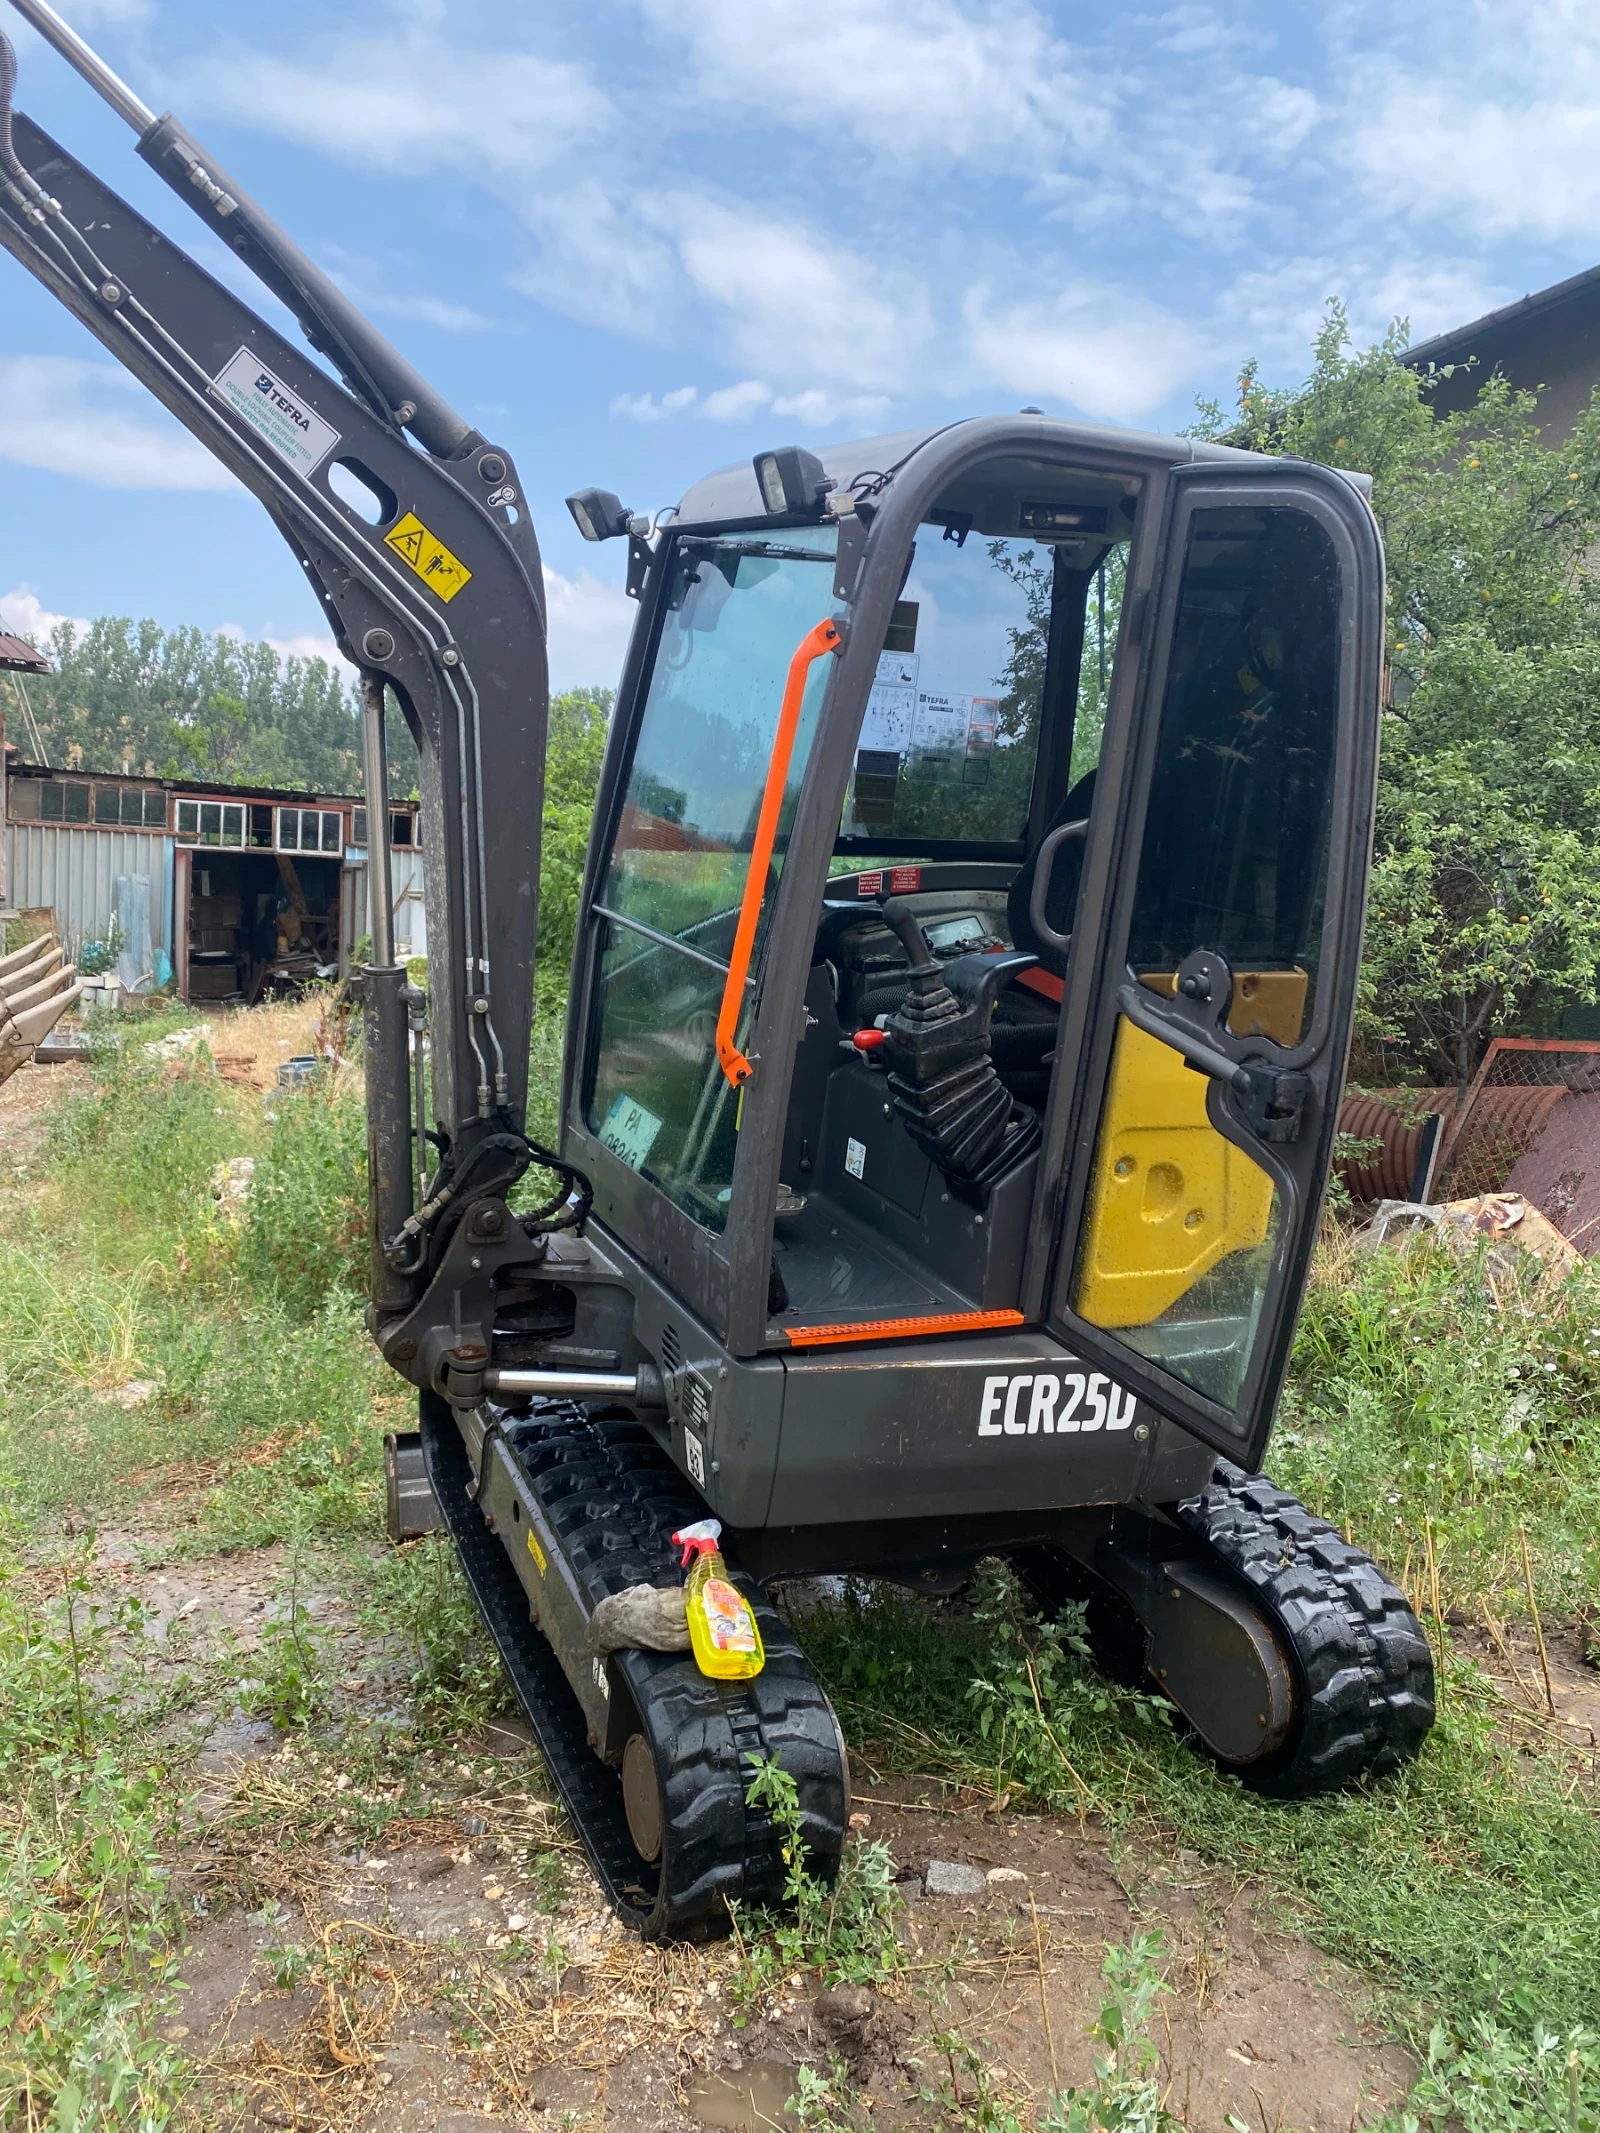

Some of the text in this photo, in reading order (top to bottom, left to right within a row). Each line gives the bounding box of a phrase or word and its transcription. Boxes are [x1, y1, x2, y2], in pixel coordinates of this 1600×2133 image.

[225, 380, 312, 460] DOUBLE LOCKING COUPLER FITTED
[240, 405, 260, 425] SAFETY
[258, 422, 270, 435] PIN
[269, 431, 297, 459] REQUIRED
[252, 392, 299, 436] FULLY AUTOMATIC
[270, 388, 310, 432] TEFRA
[927, 696, 949, 705] TEFRA
[624, 1108, 643, 1135] PA
[978, 1372, 1137, 1436] ECR25D
[689, 1447, 700, 1480] 93
